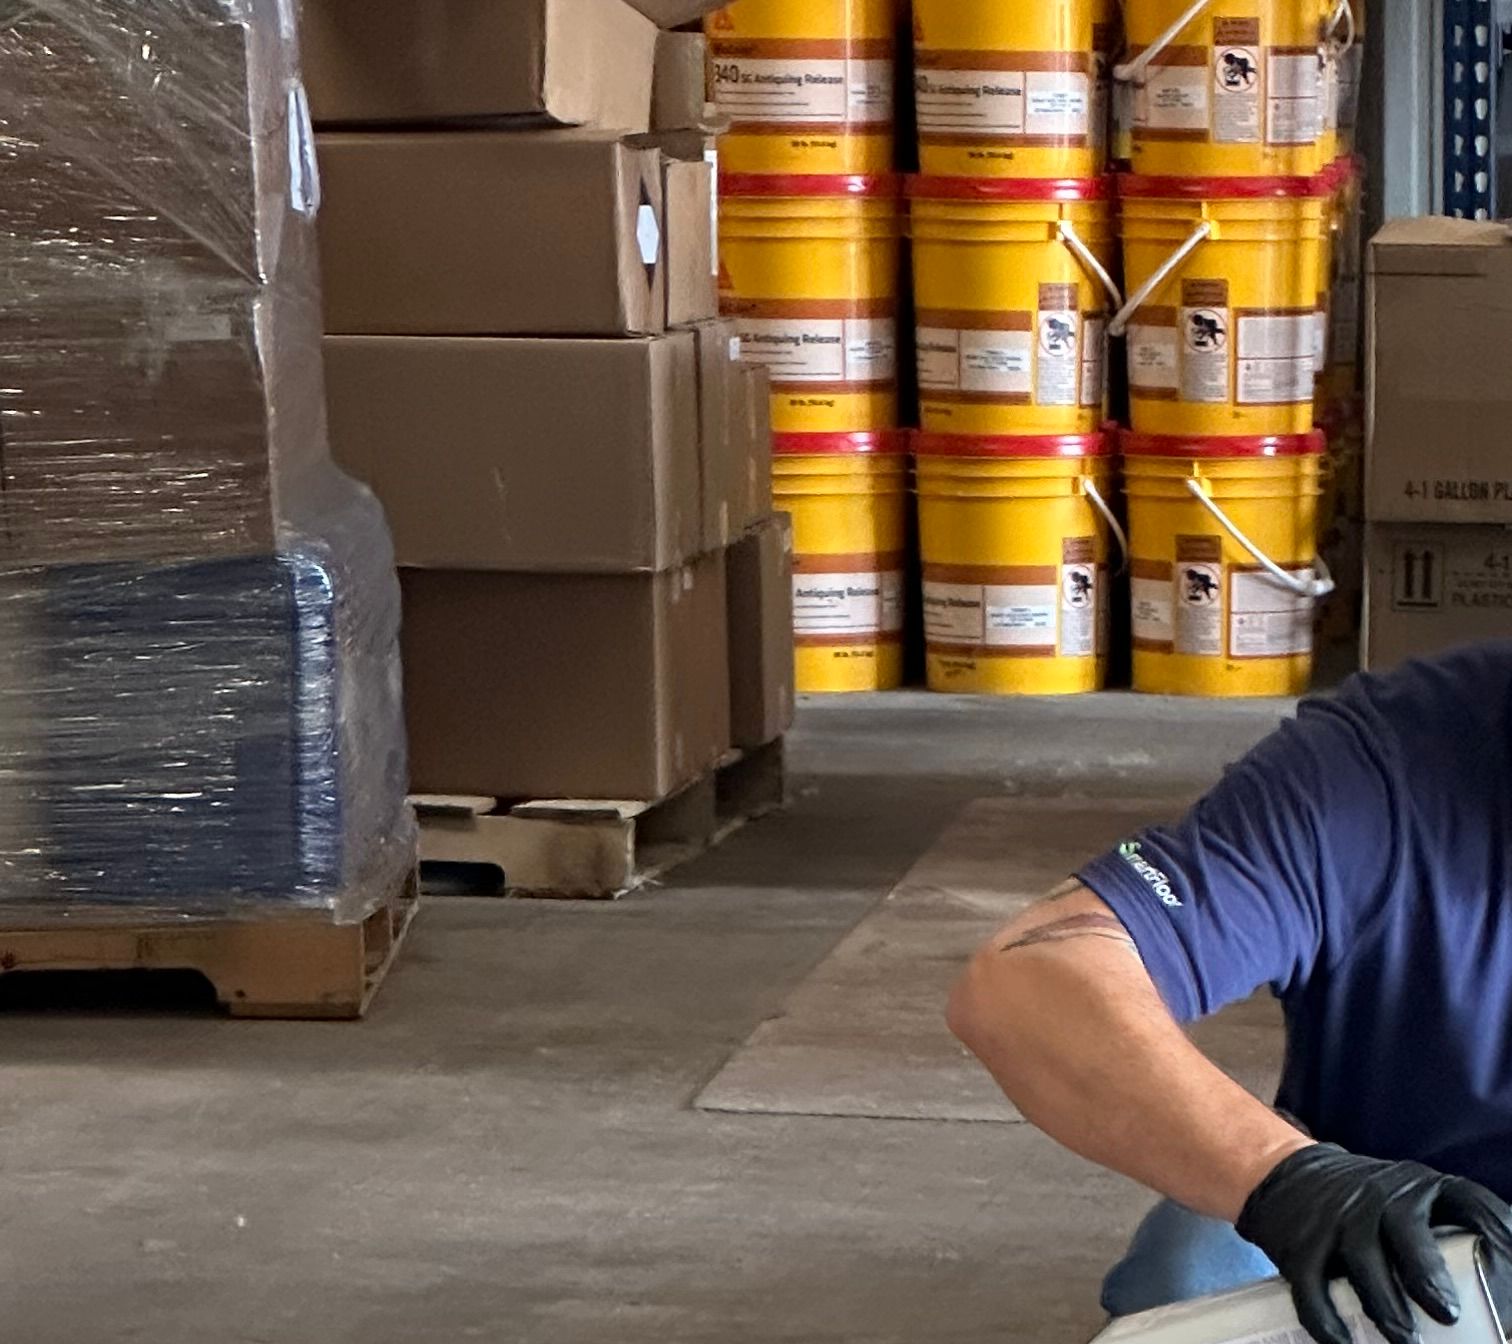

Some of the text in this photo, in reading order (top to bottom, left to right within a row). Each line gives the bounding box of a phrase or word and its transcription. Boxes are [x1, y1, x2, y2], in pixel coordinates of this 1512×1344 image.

[804, 73, 844, 84] Release
[802, 333, 841, 344] Release
[1404, 479, 1428, 499] 4-1
[1433, 480, 1489, 501] GALLON
